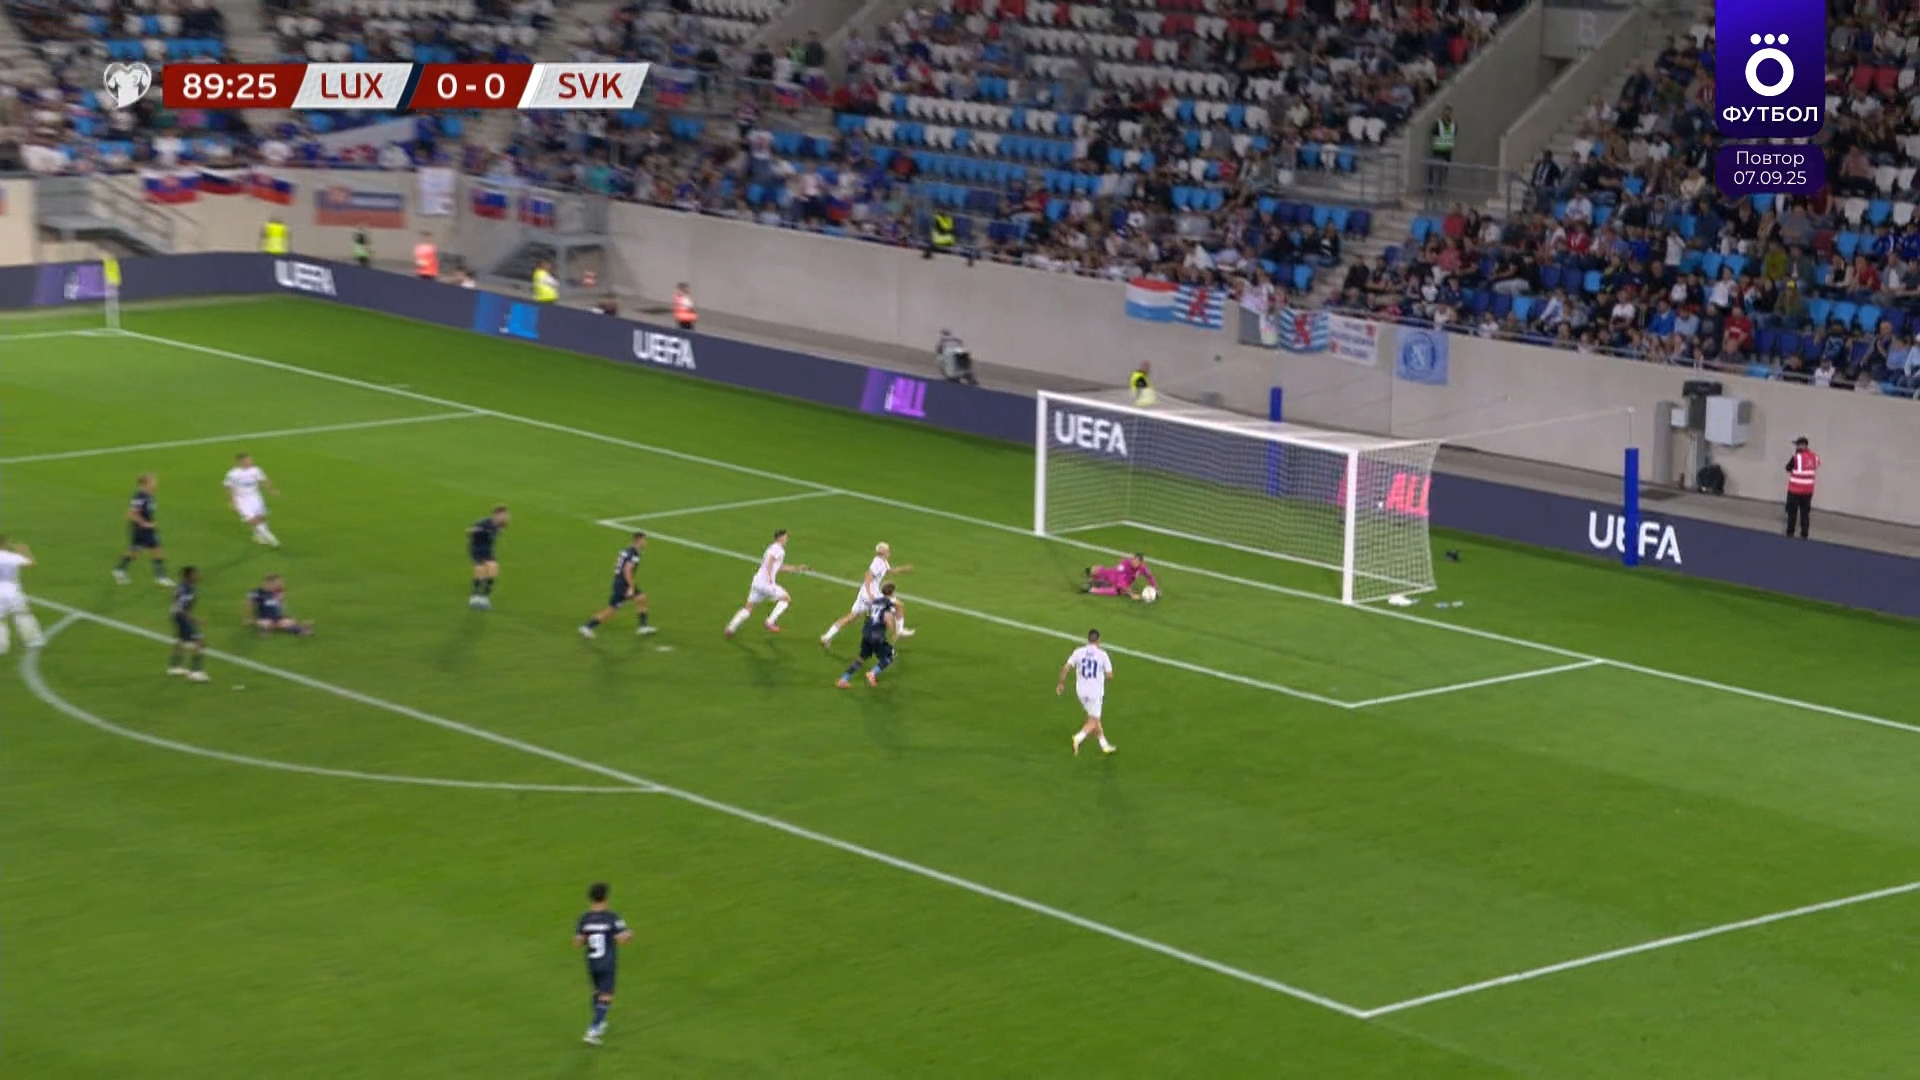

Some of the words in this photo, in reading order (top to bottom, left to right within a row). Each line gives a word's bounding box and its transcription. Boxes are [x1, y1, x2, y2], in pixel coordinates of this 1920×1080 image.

[632, 329, 696, 370] UEFA
[1055, 410, 1128, 456] UEFA
[1081, 657, 1098, 679] 21
[587, 933, 606, 959] 9
